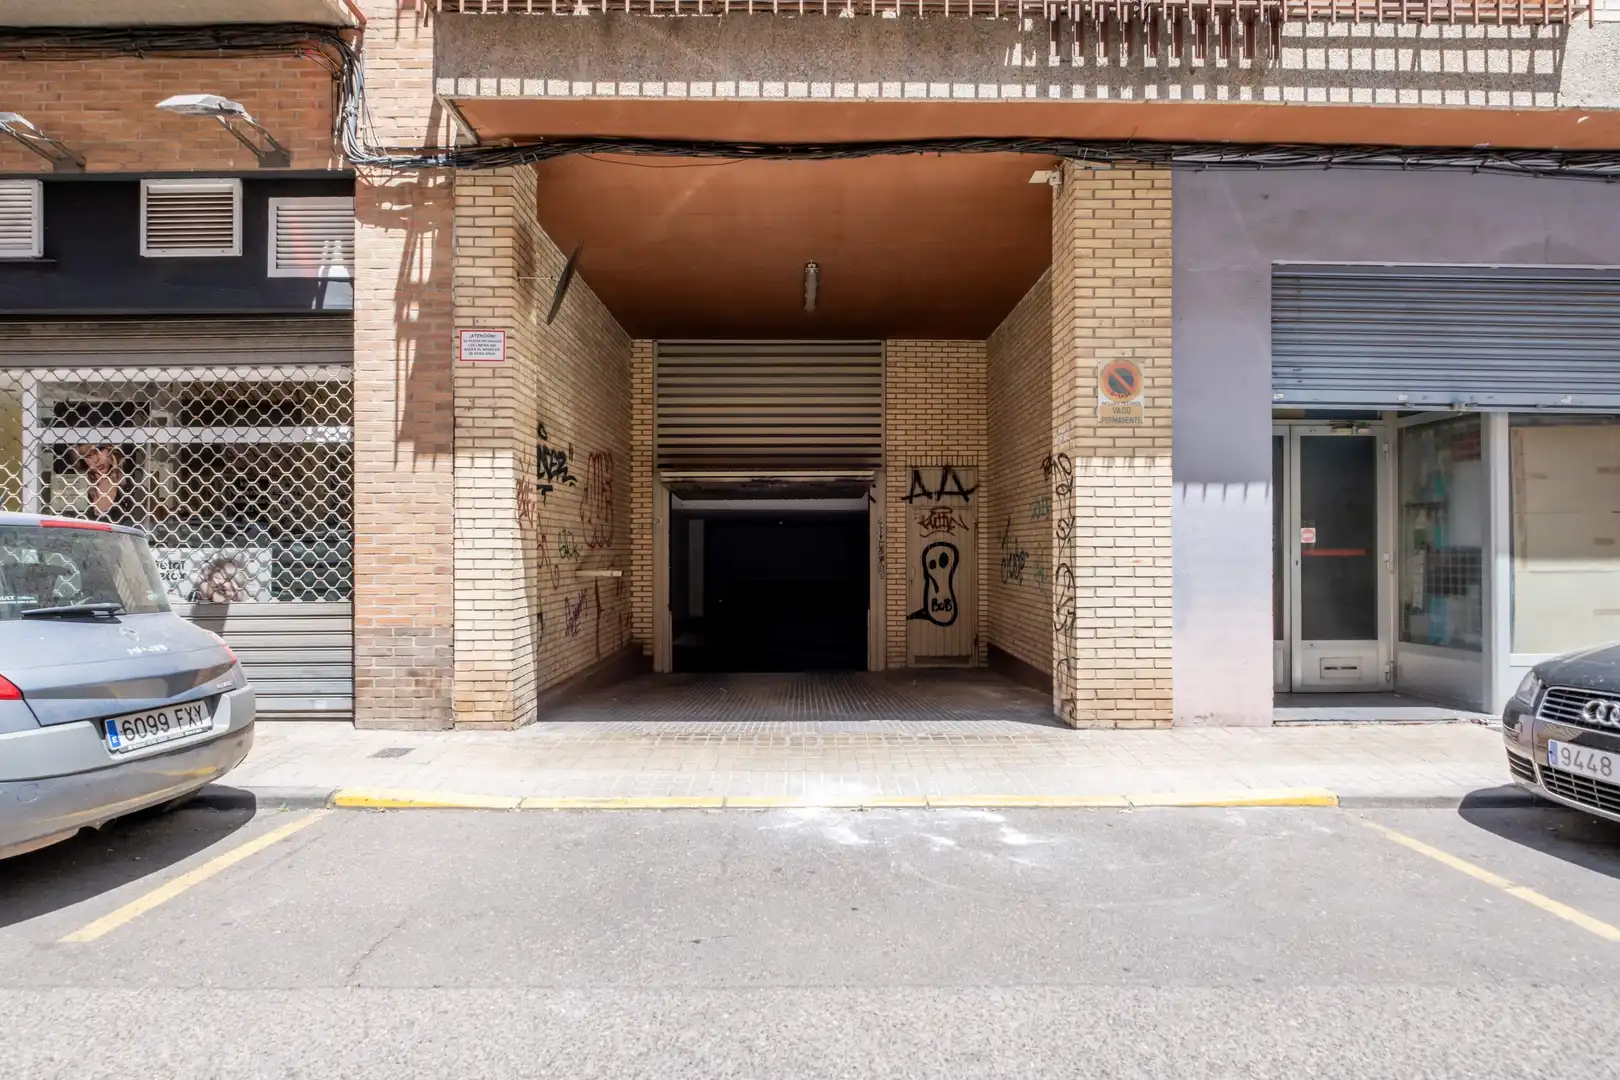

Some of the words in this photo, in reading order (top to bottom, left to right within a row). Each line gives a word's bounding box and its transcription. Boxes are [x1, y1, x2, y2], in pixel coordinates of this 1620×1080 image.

[1101, 416, 1142, 424] PERMANENTE
[122, 712, 170, 741] 6099
[174, 704, 204, 730] FXY
[111, 736, 118, 744] E
[1561, 747, 1612, 777] 9448
